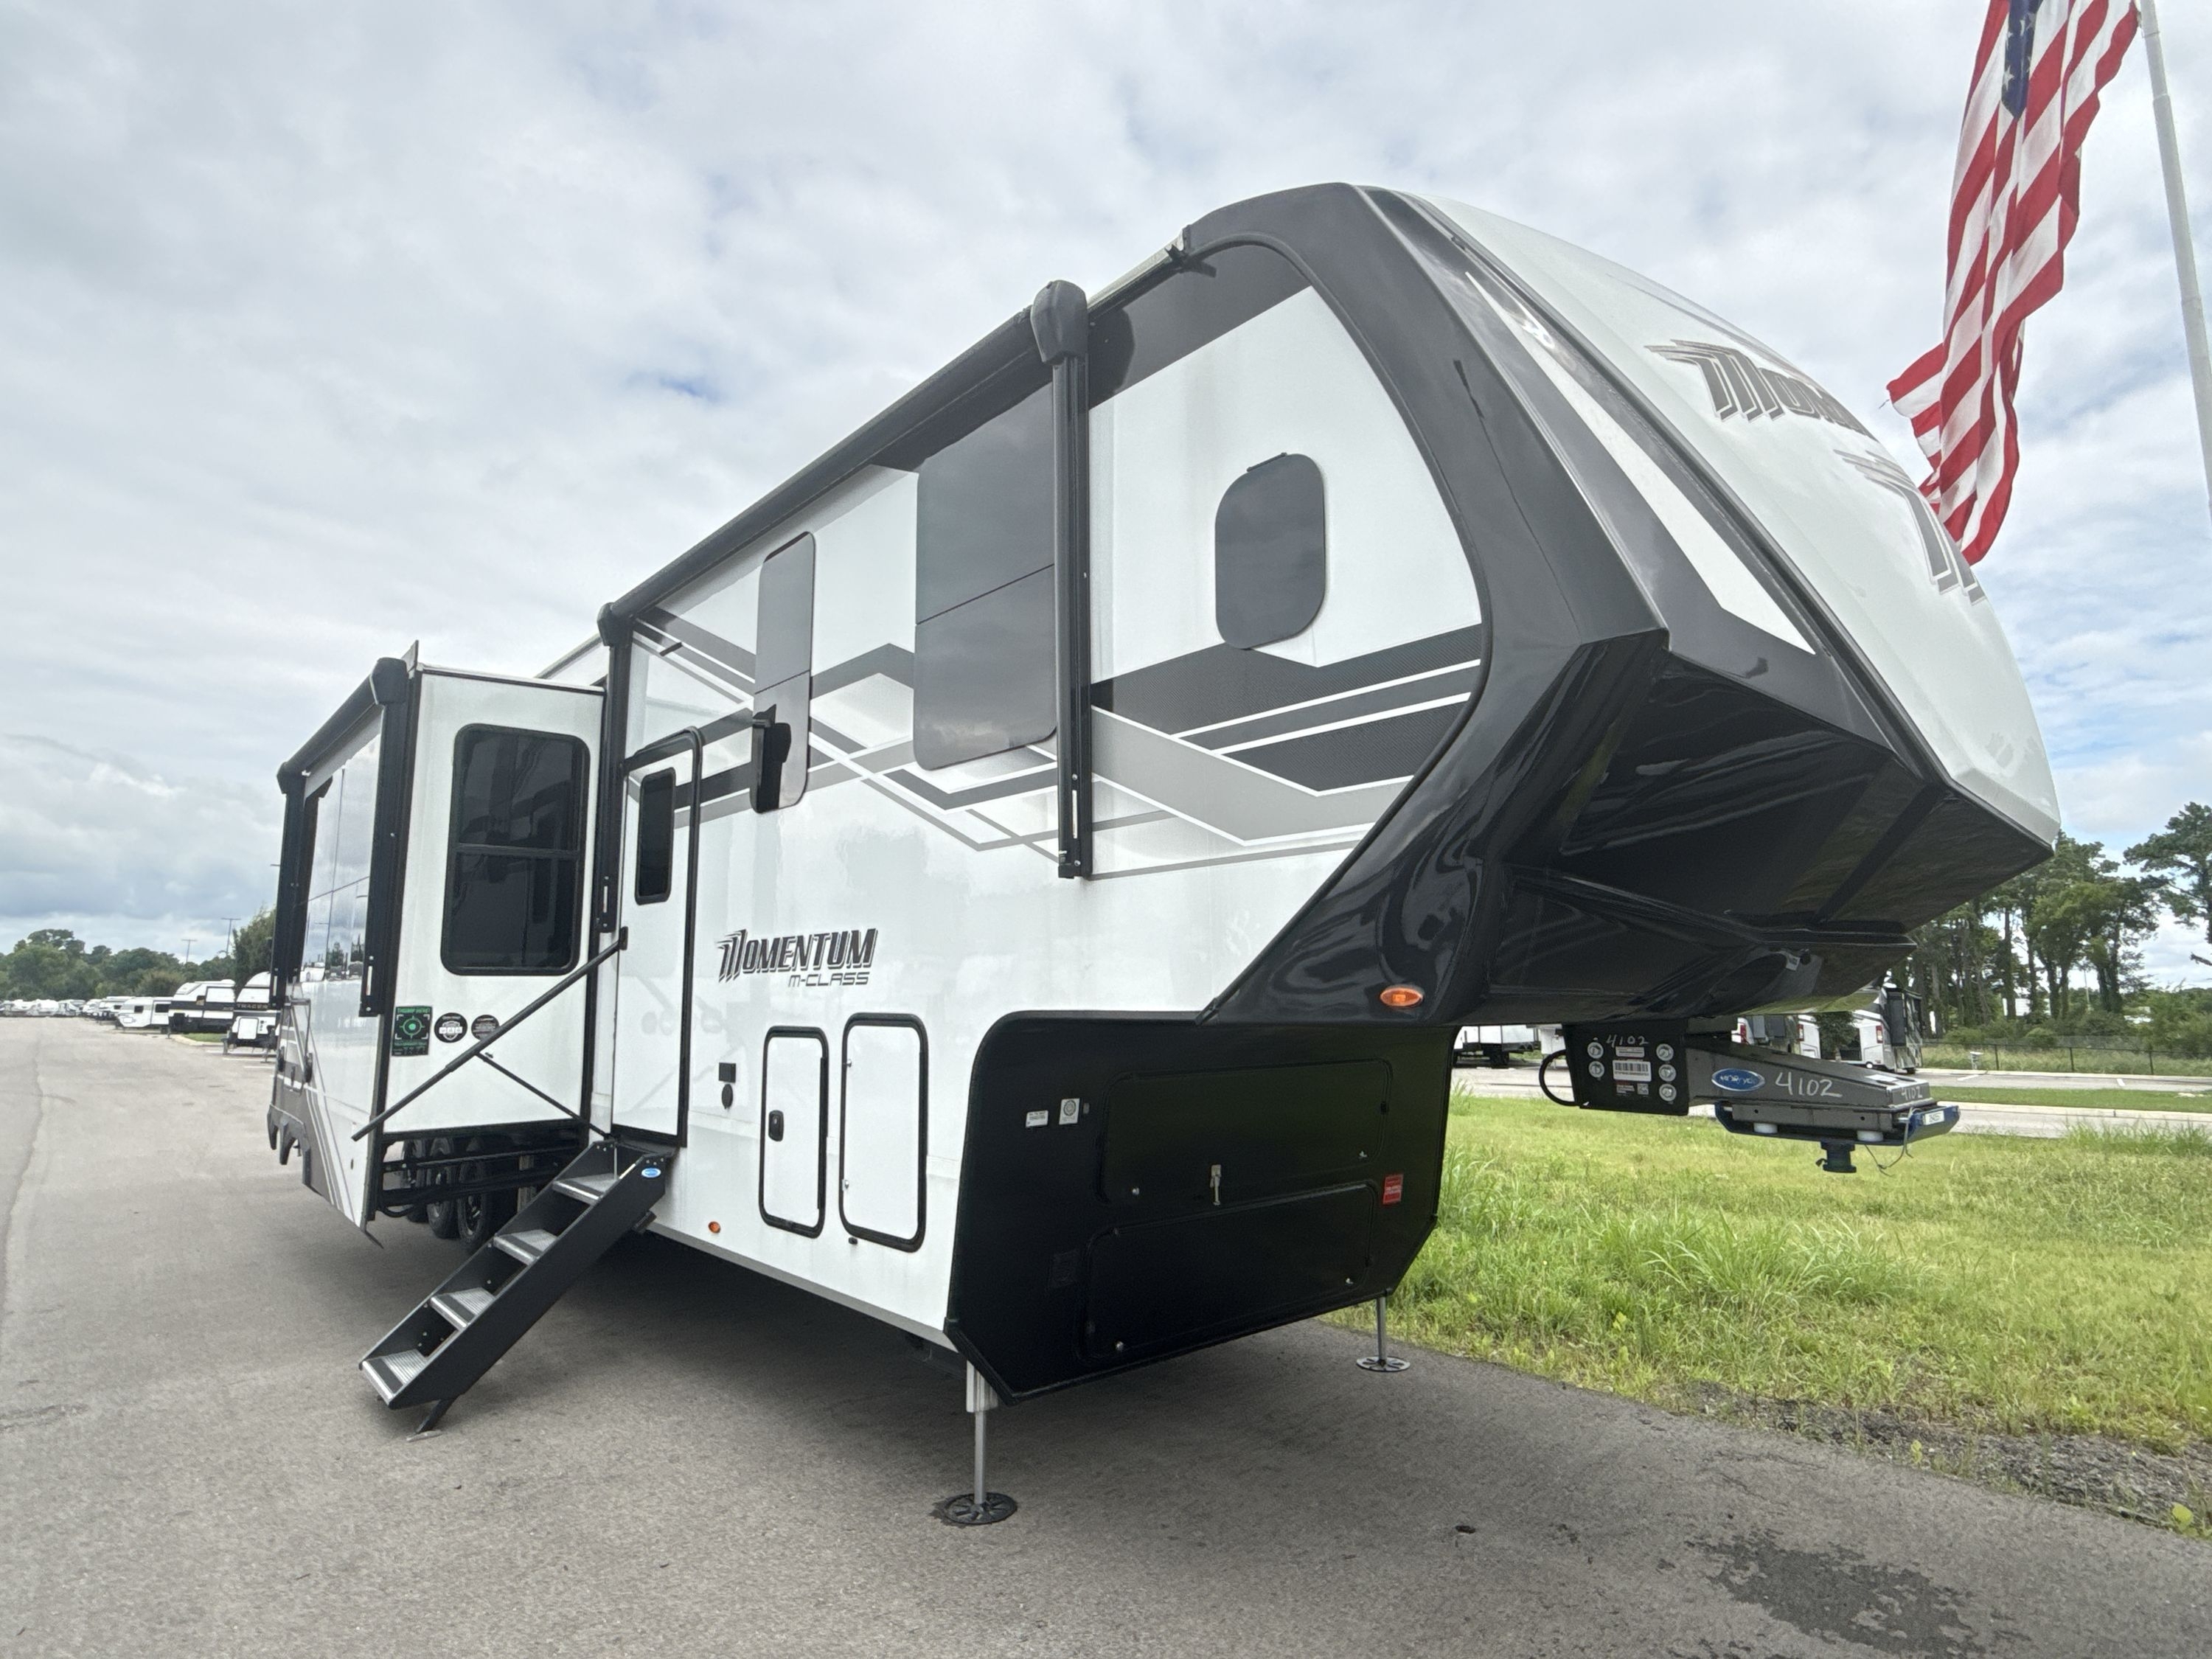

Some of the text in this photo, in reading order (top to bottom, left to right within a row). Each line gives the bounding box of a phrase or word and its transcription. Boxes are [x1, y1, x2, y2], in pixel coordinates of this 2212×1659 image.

[716, 928, 878, 983] MOMENTUM
[1606, 1034, 1649, 1048] 4102
[1775, 1071, 1843, 1097] 4102
[1901, 1085, 1923, 1101] 4102
